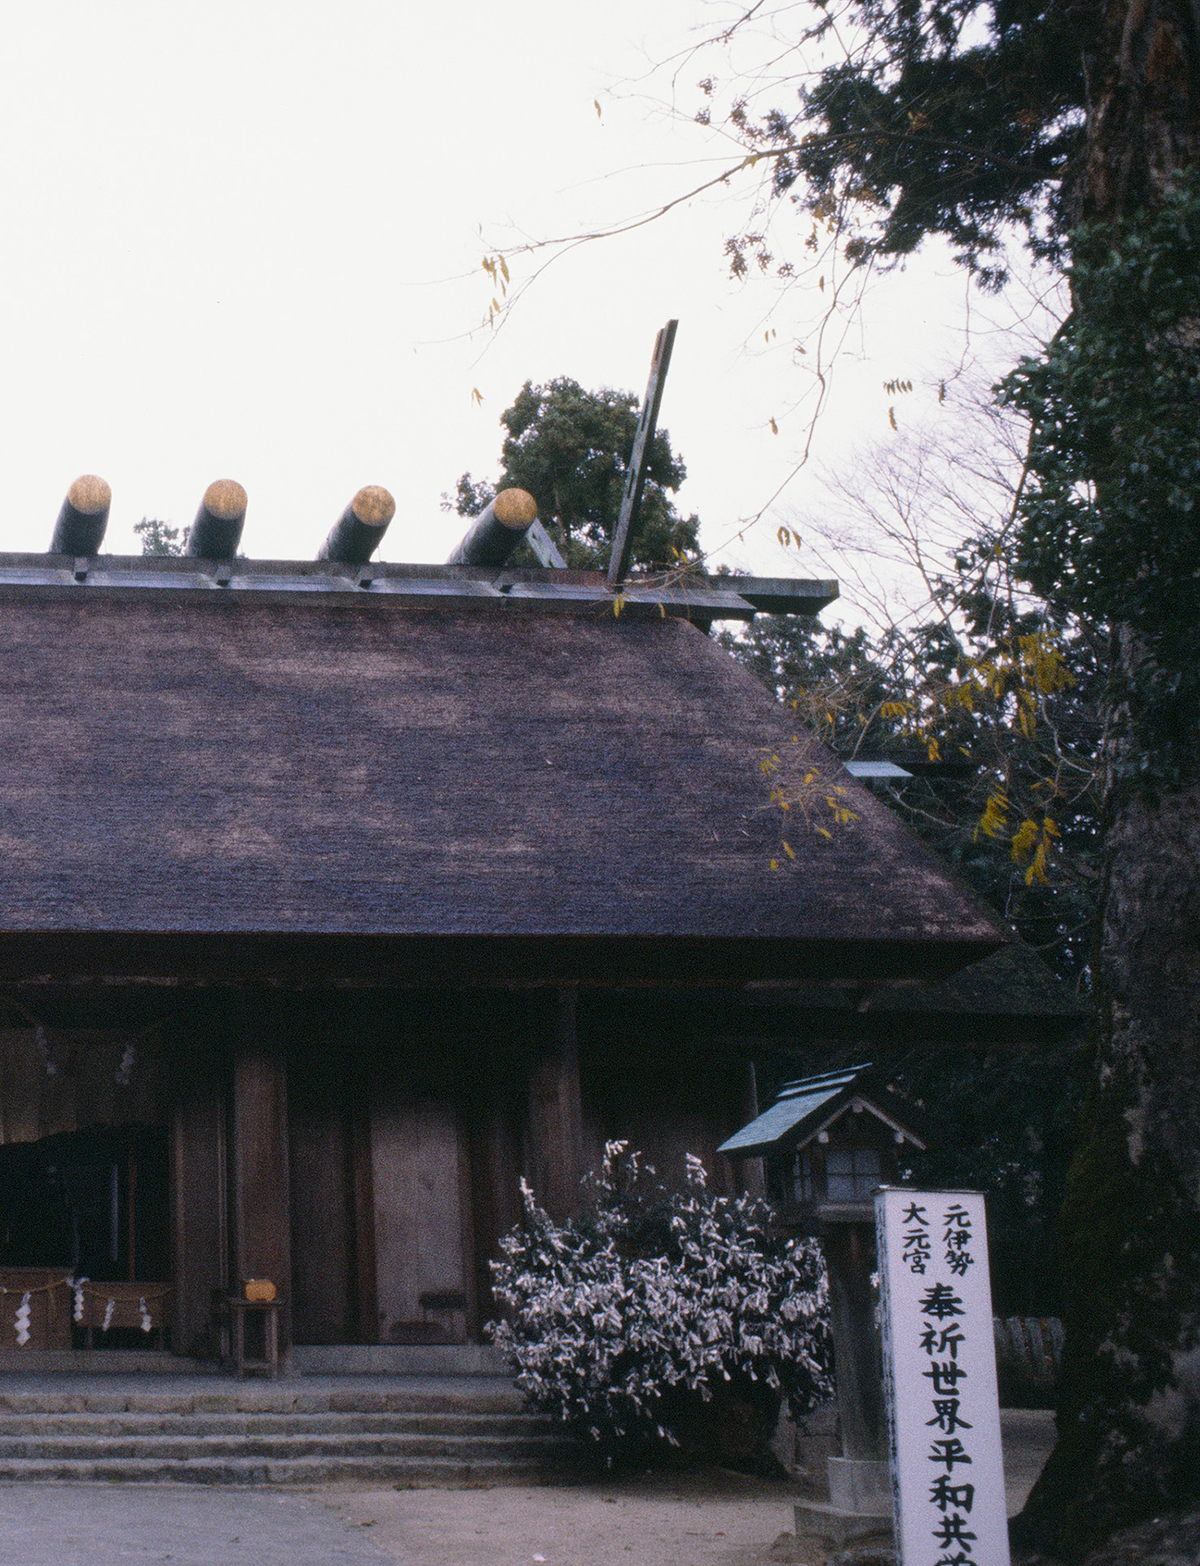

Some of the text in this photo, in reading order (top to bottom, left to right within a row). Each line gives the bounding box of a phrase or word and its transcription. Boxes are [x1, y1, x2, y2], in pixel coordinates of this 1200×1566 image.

[902, 1202, 931, 1275] 大元宮
[942, 1204, 975, 1277] 元伊勢
